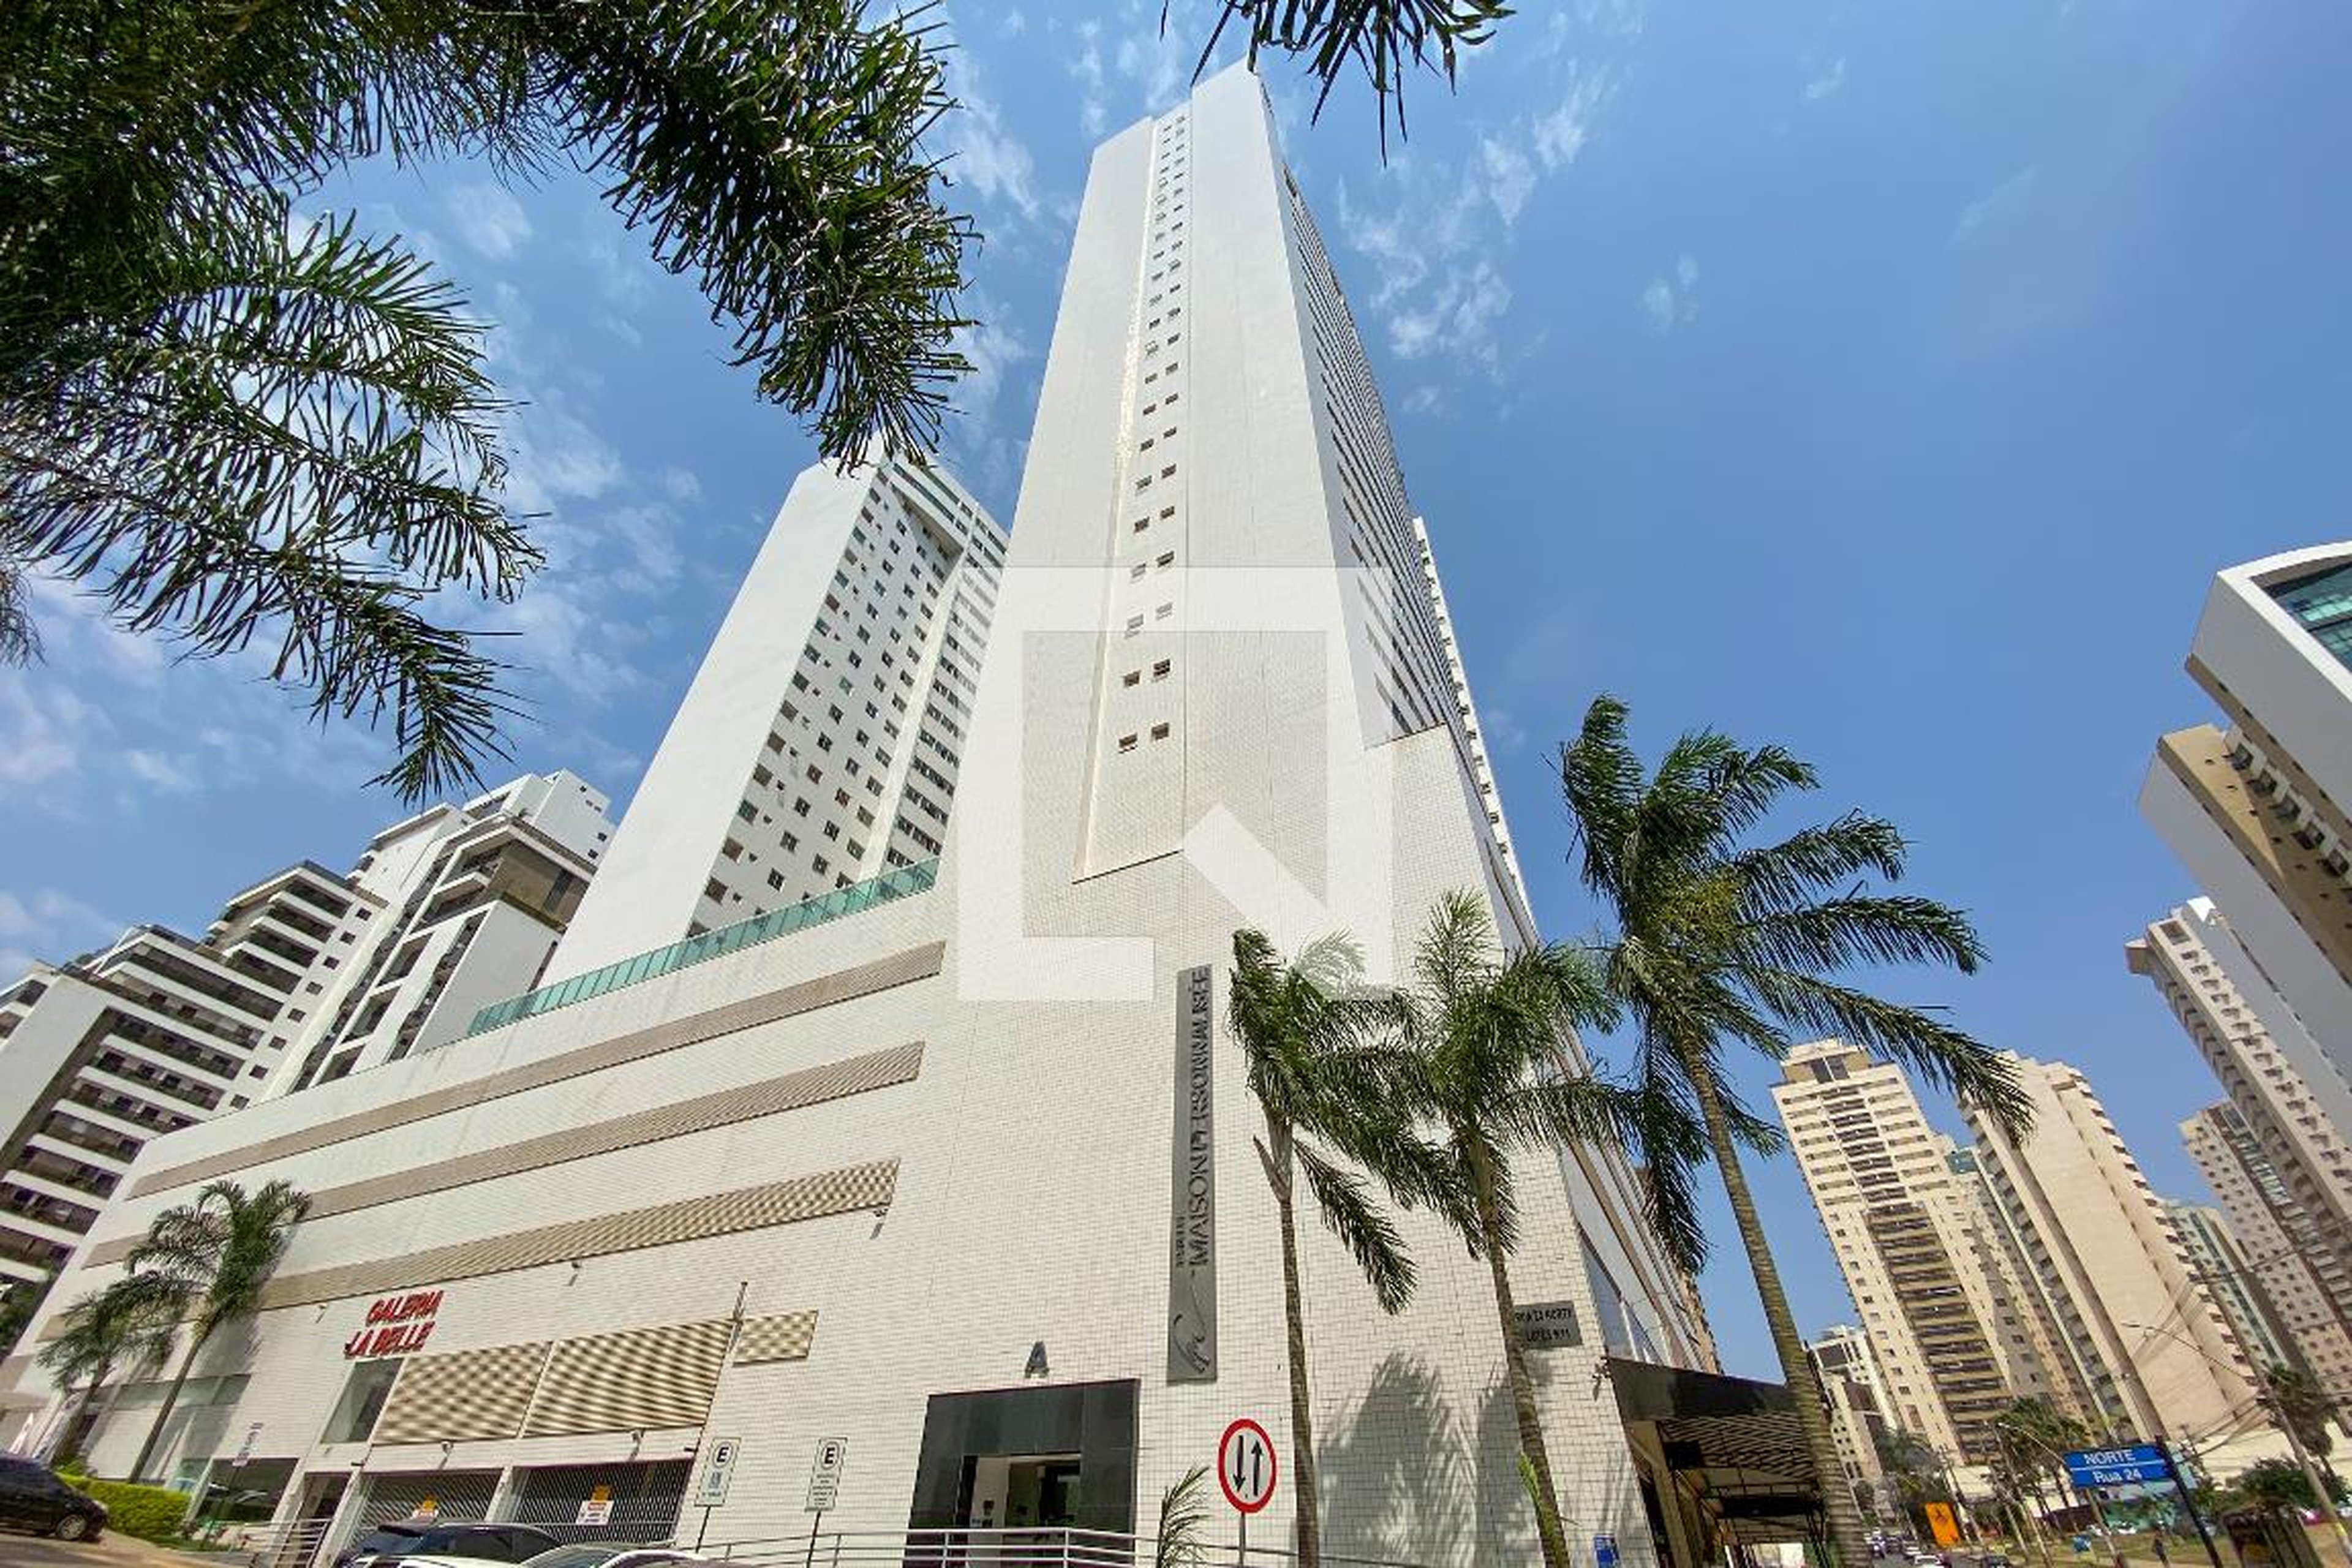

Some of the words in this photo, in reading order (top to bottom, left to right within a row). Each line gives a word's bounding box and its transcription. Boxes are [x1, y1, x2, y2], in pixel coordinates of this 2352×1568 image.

[1188, 1154, 1210, 1266] MAISON
[366, 1290, 443, 1327] GALERIA
[369, 1321, 435, 1357] BELLE
[1025, 1341, 1049, 1378] A
[716, 1447, 729, 1463] E
[824, 1447, 835, 1464] E
[2083, 1449, 2136, 1464] NORTE
[2092, 1469, 2123, 1483] Rua
[2123, 1468, 2143, 1481] 24
